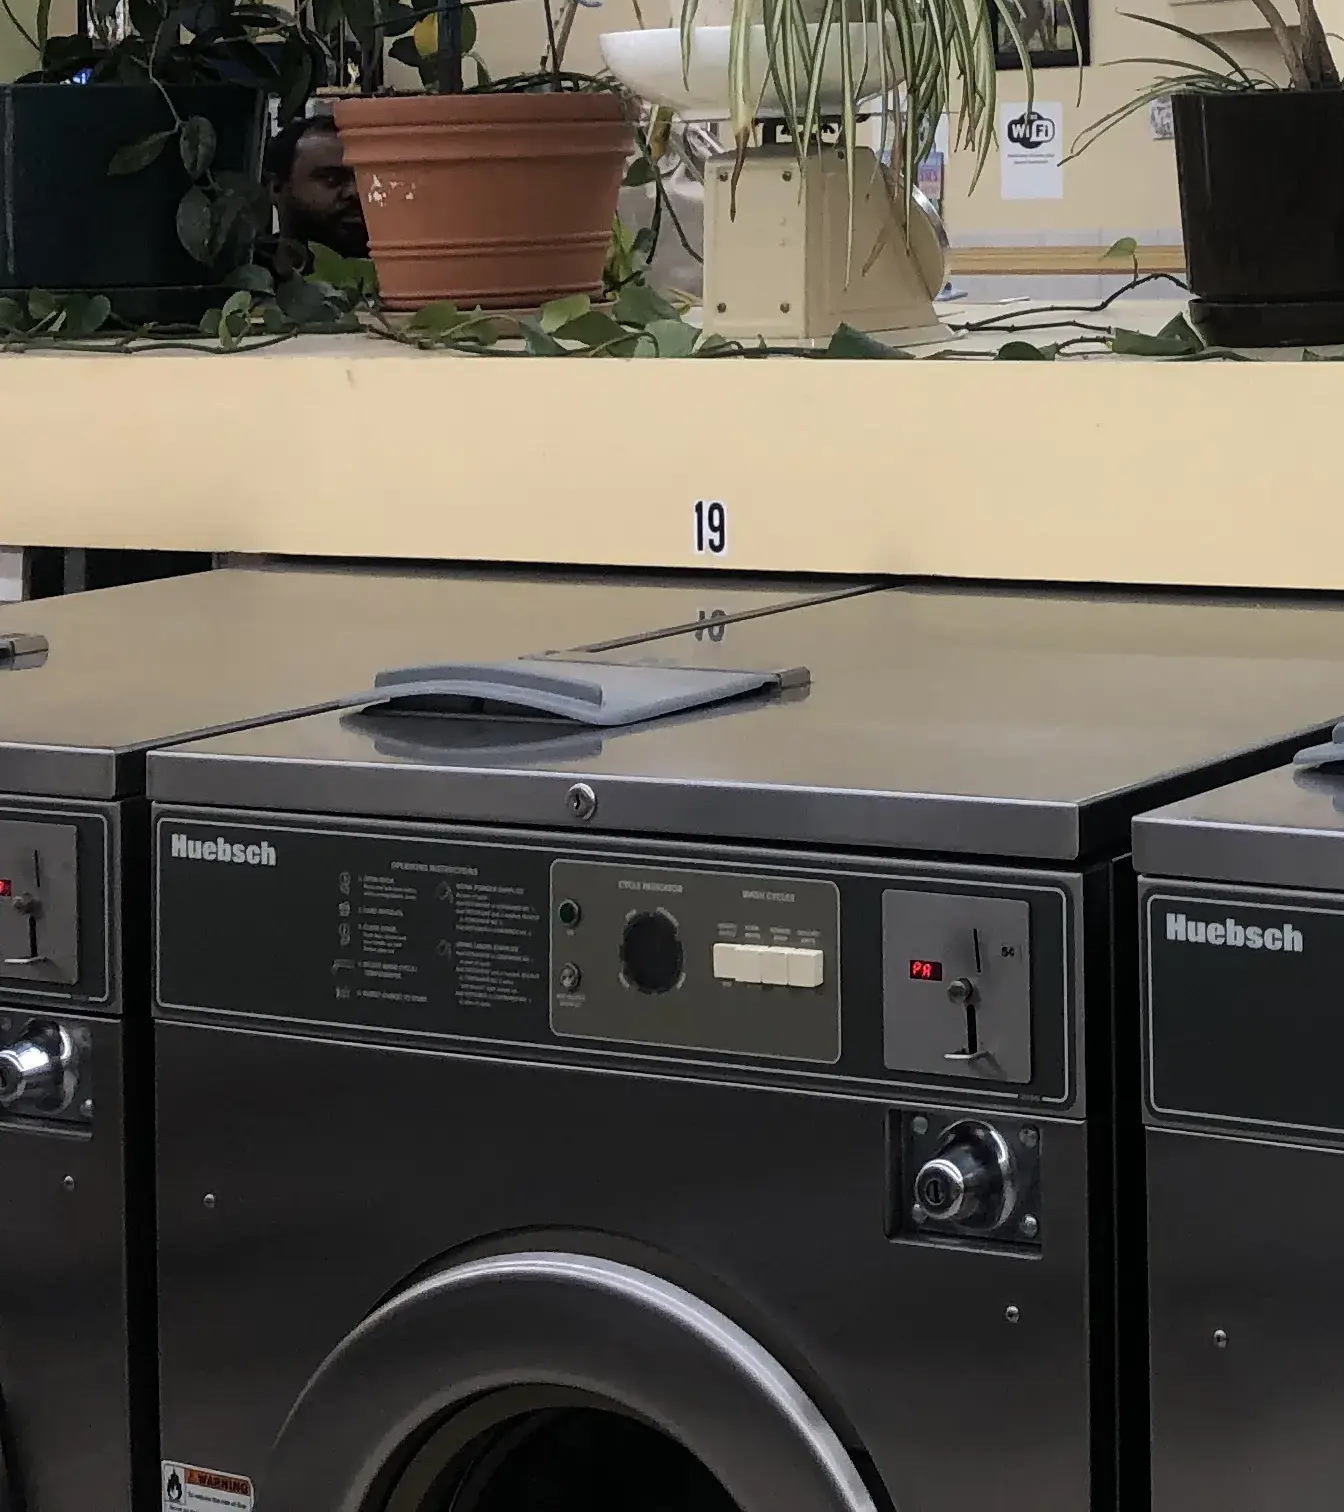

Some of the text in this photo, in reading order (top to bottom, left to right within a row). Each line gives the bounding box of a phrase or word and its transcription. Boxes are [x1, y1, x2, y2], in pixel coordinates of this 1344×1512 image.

[694, 500, 726, 554] 19
[171, 833, 277, 866] Huebsch
[1166, 912, 1304, 952] Huebsch
[198, 1473, 249, 1496] WARNING
